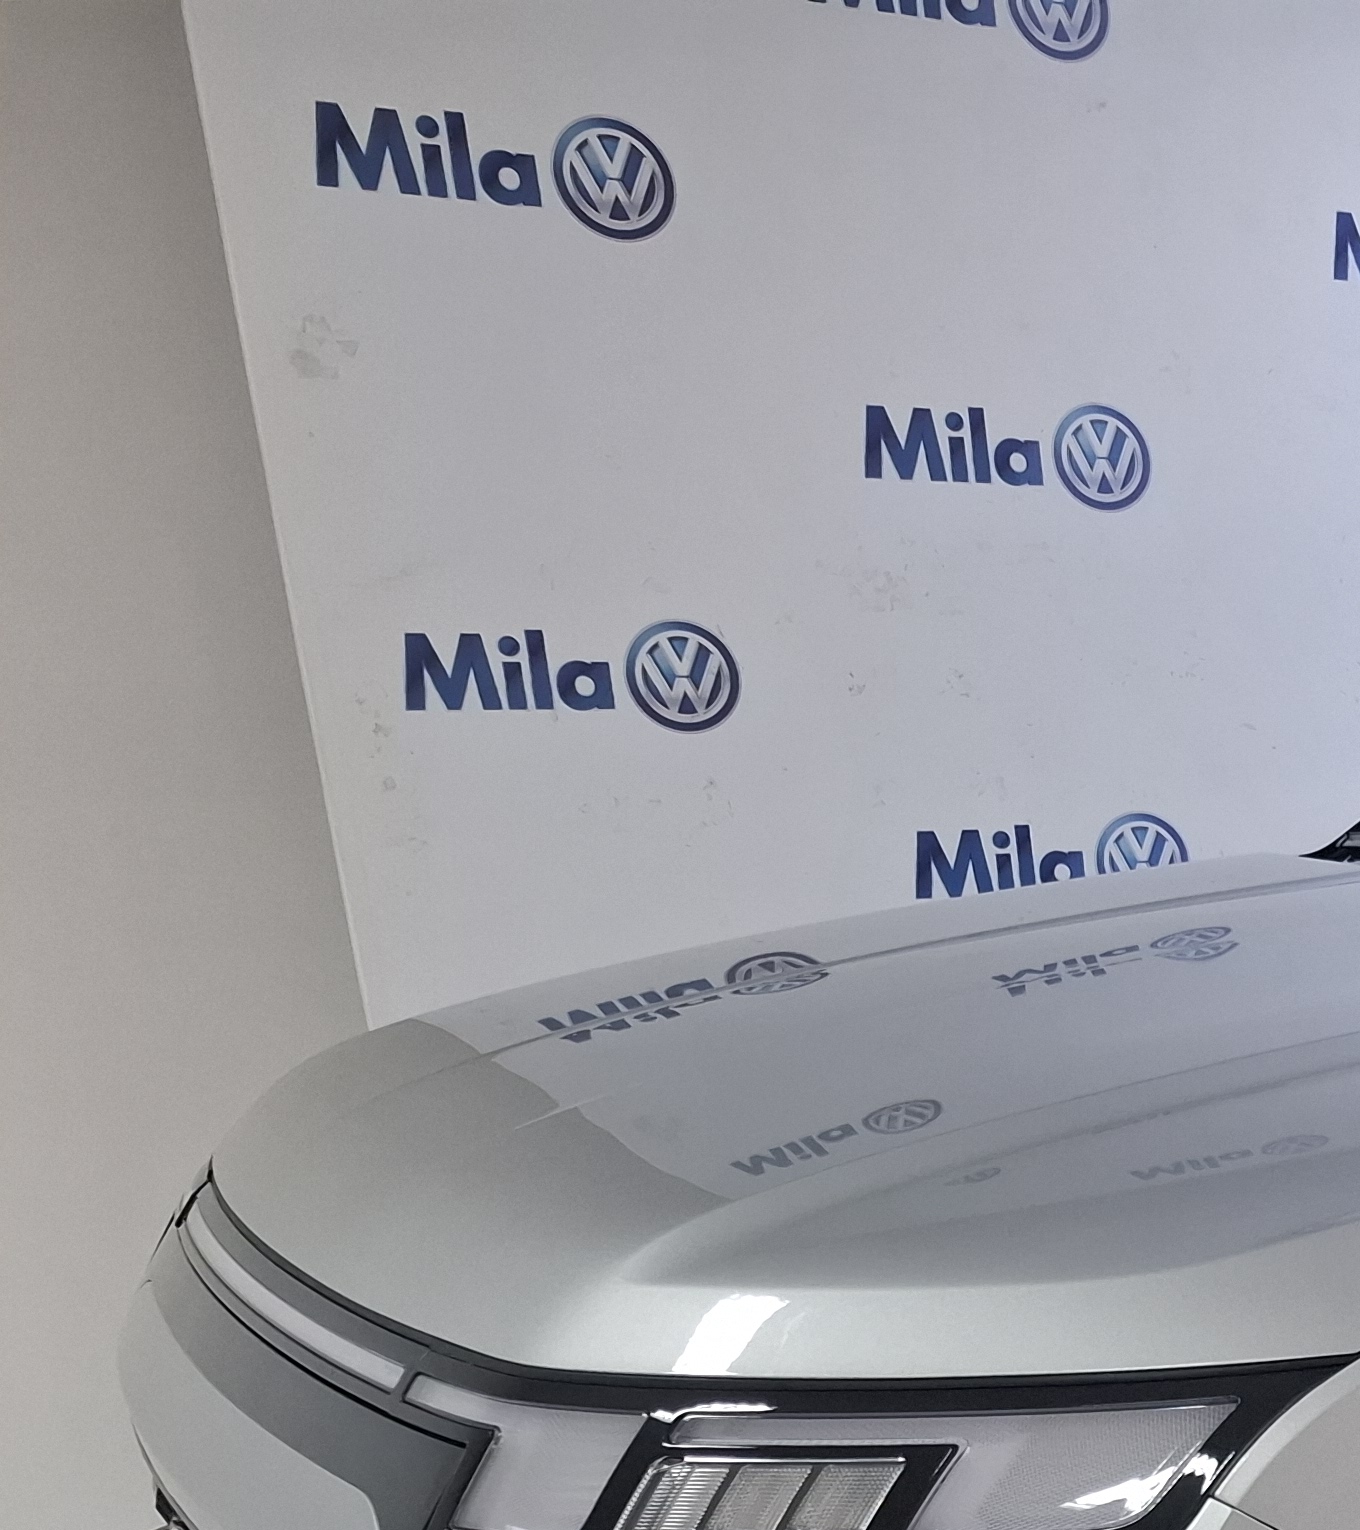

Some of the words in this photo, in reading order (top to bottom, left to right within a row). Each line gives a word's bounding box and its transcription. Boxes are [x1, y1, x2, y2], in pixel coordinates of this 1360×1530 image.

[316, 101, 542, 207] Mila
[865, 405, 1043, 486] Mila
[405, 630, 615, 710] Mila
[916, 824, 1085, 899] Mila
